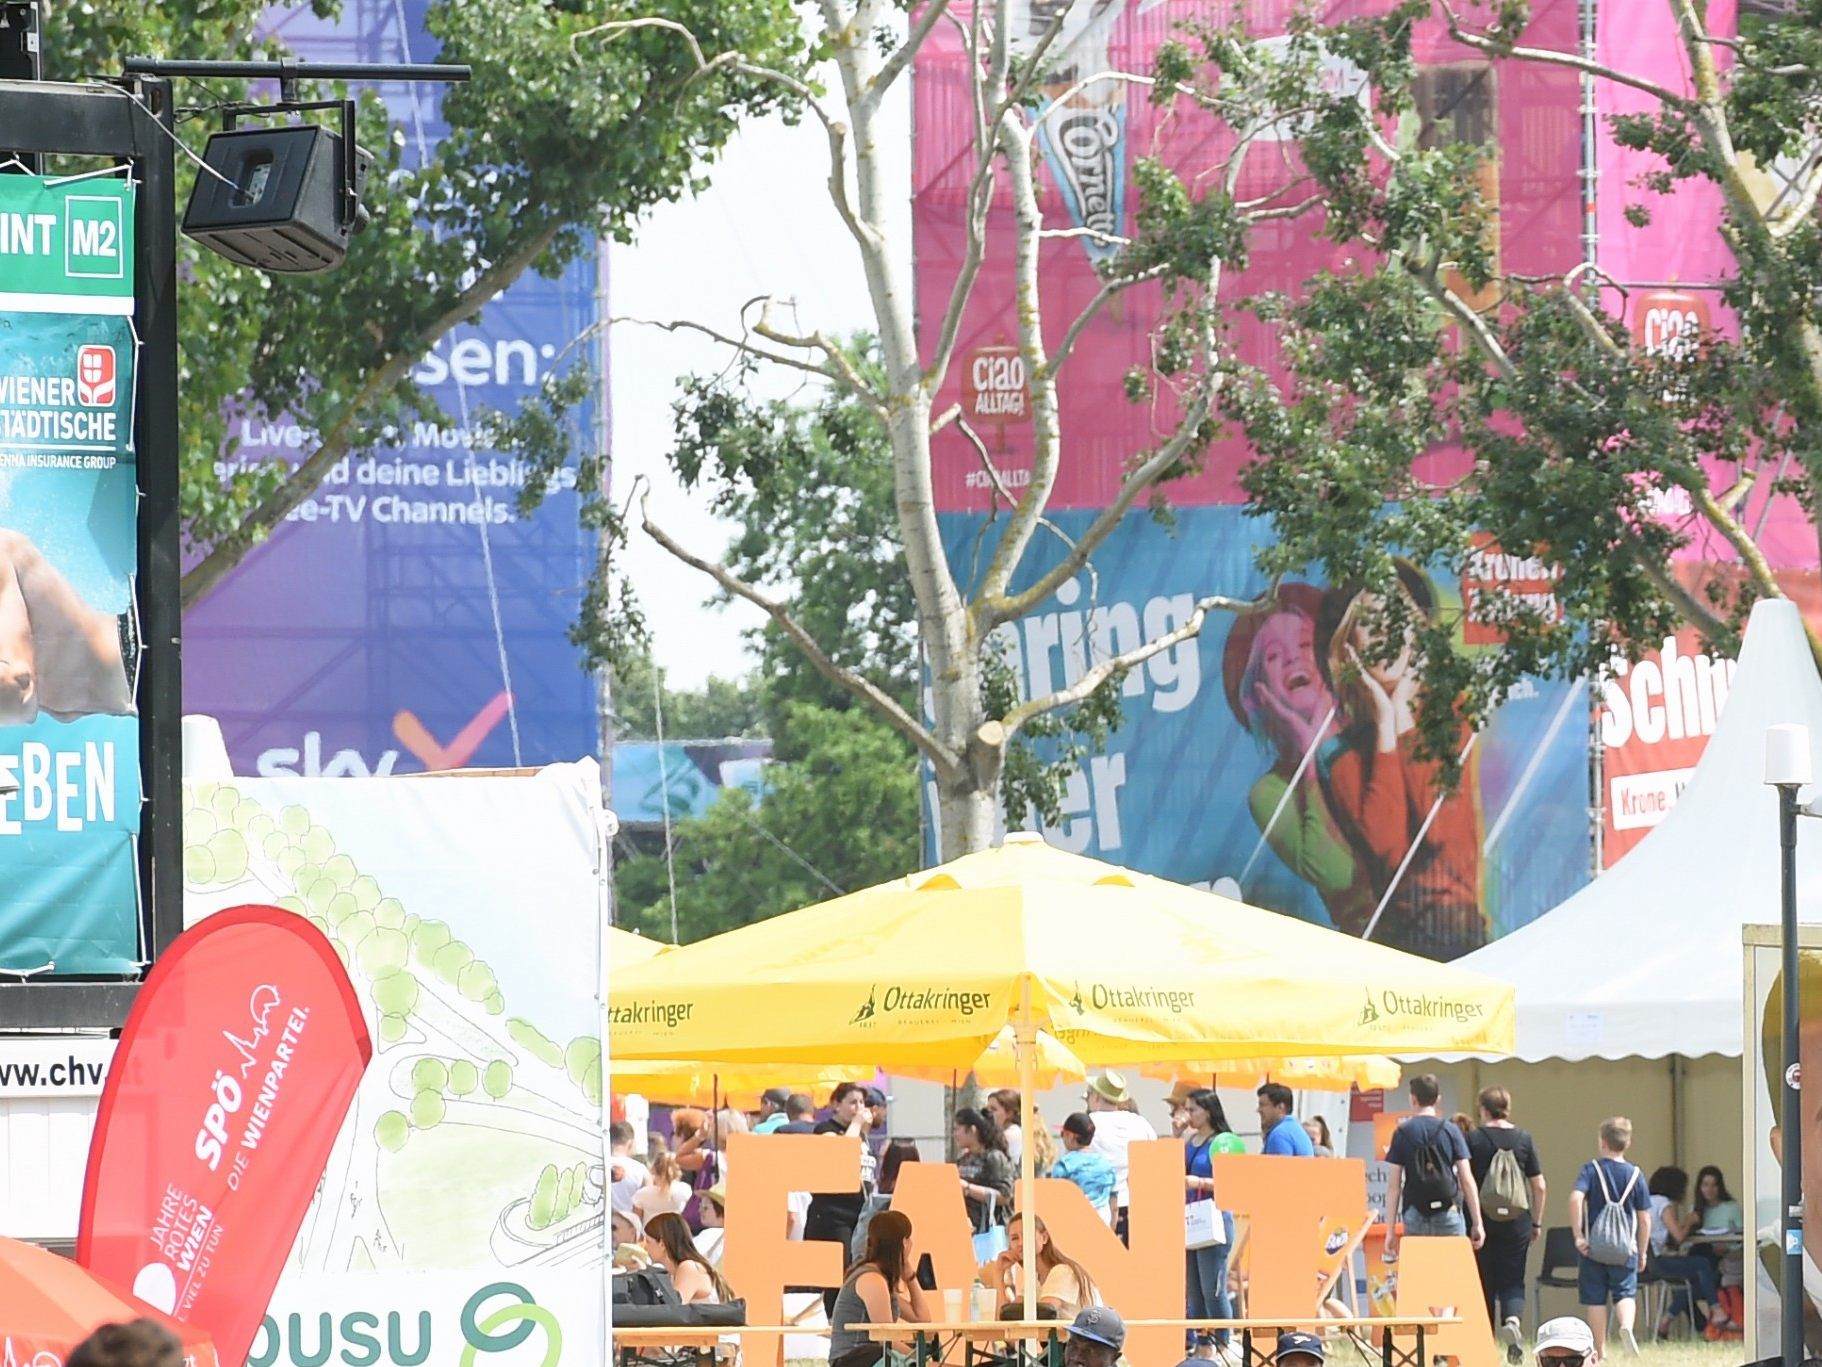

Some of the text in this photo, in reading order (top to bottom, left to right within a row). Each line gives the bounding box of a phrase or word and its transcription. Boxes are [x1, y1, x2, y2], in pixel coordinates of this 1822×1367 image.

[72, 219, 117, 257] M2
[972, 356, 1025, 391] Ciao
[0, 409, 117, 441] TÄDTISCHE
[83, 455, 117, 470] GROUP
[356, 457, 440, 487] deine
[371, 495, 517, 525] Channels.
[883, 985, 991, 1015] Ottakringer
[1091, 982, 1196, 1014] Ottakringer
[1382, 988, 1485, 1023] Ottakringer
[227, 1006, 311, 1191] DIE WIENPARTEI.
[195, 1069, 243, 1172] SPÖ
[149, 1183, 183, 1251] JAHRE
[164, 1194, 198, 1262] ROTES
[176, 1205, 213, 1272] WIEN
